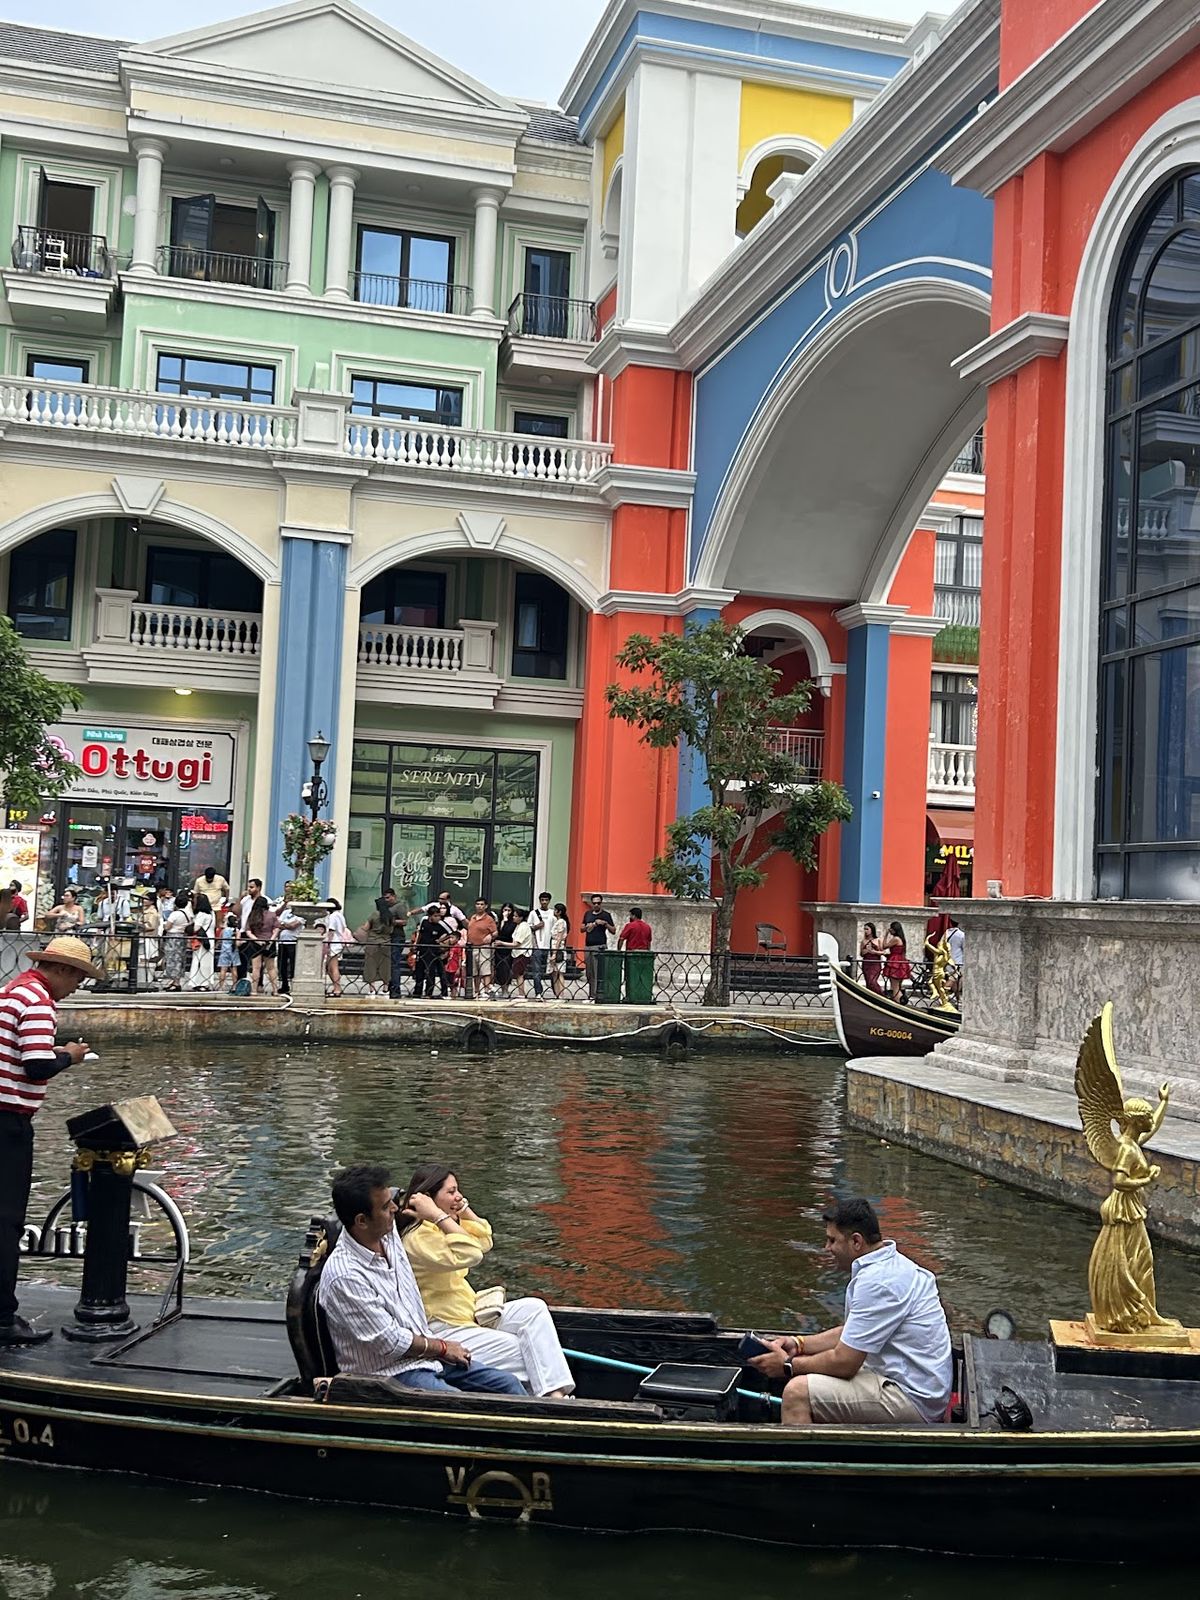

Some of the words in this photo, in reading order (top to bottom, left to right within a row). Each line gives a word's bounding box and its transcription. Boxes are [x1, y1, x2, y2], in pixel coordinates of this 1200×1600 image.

[86, 730, 102, 738] Nhà
[104, 731, 123, 740] hàng
[81, 743, 213, 791] Ottugi
[400, 769, 487, 789] SERENITY
[392, 851, 434, 872] Coffee
[394, 868, 432, 888] Time
[869, 1027, 913, 1040] KG-00004
